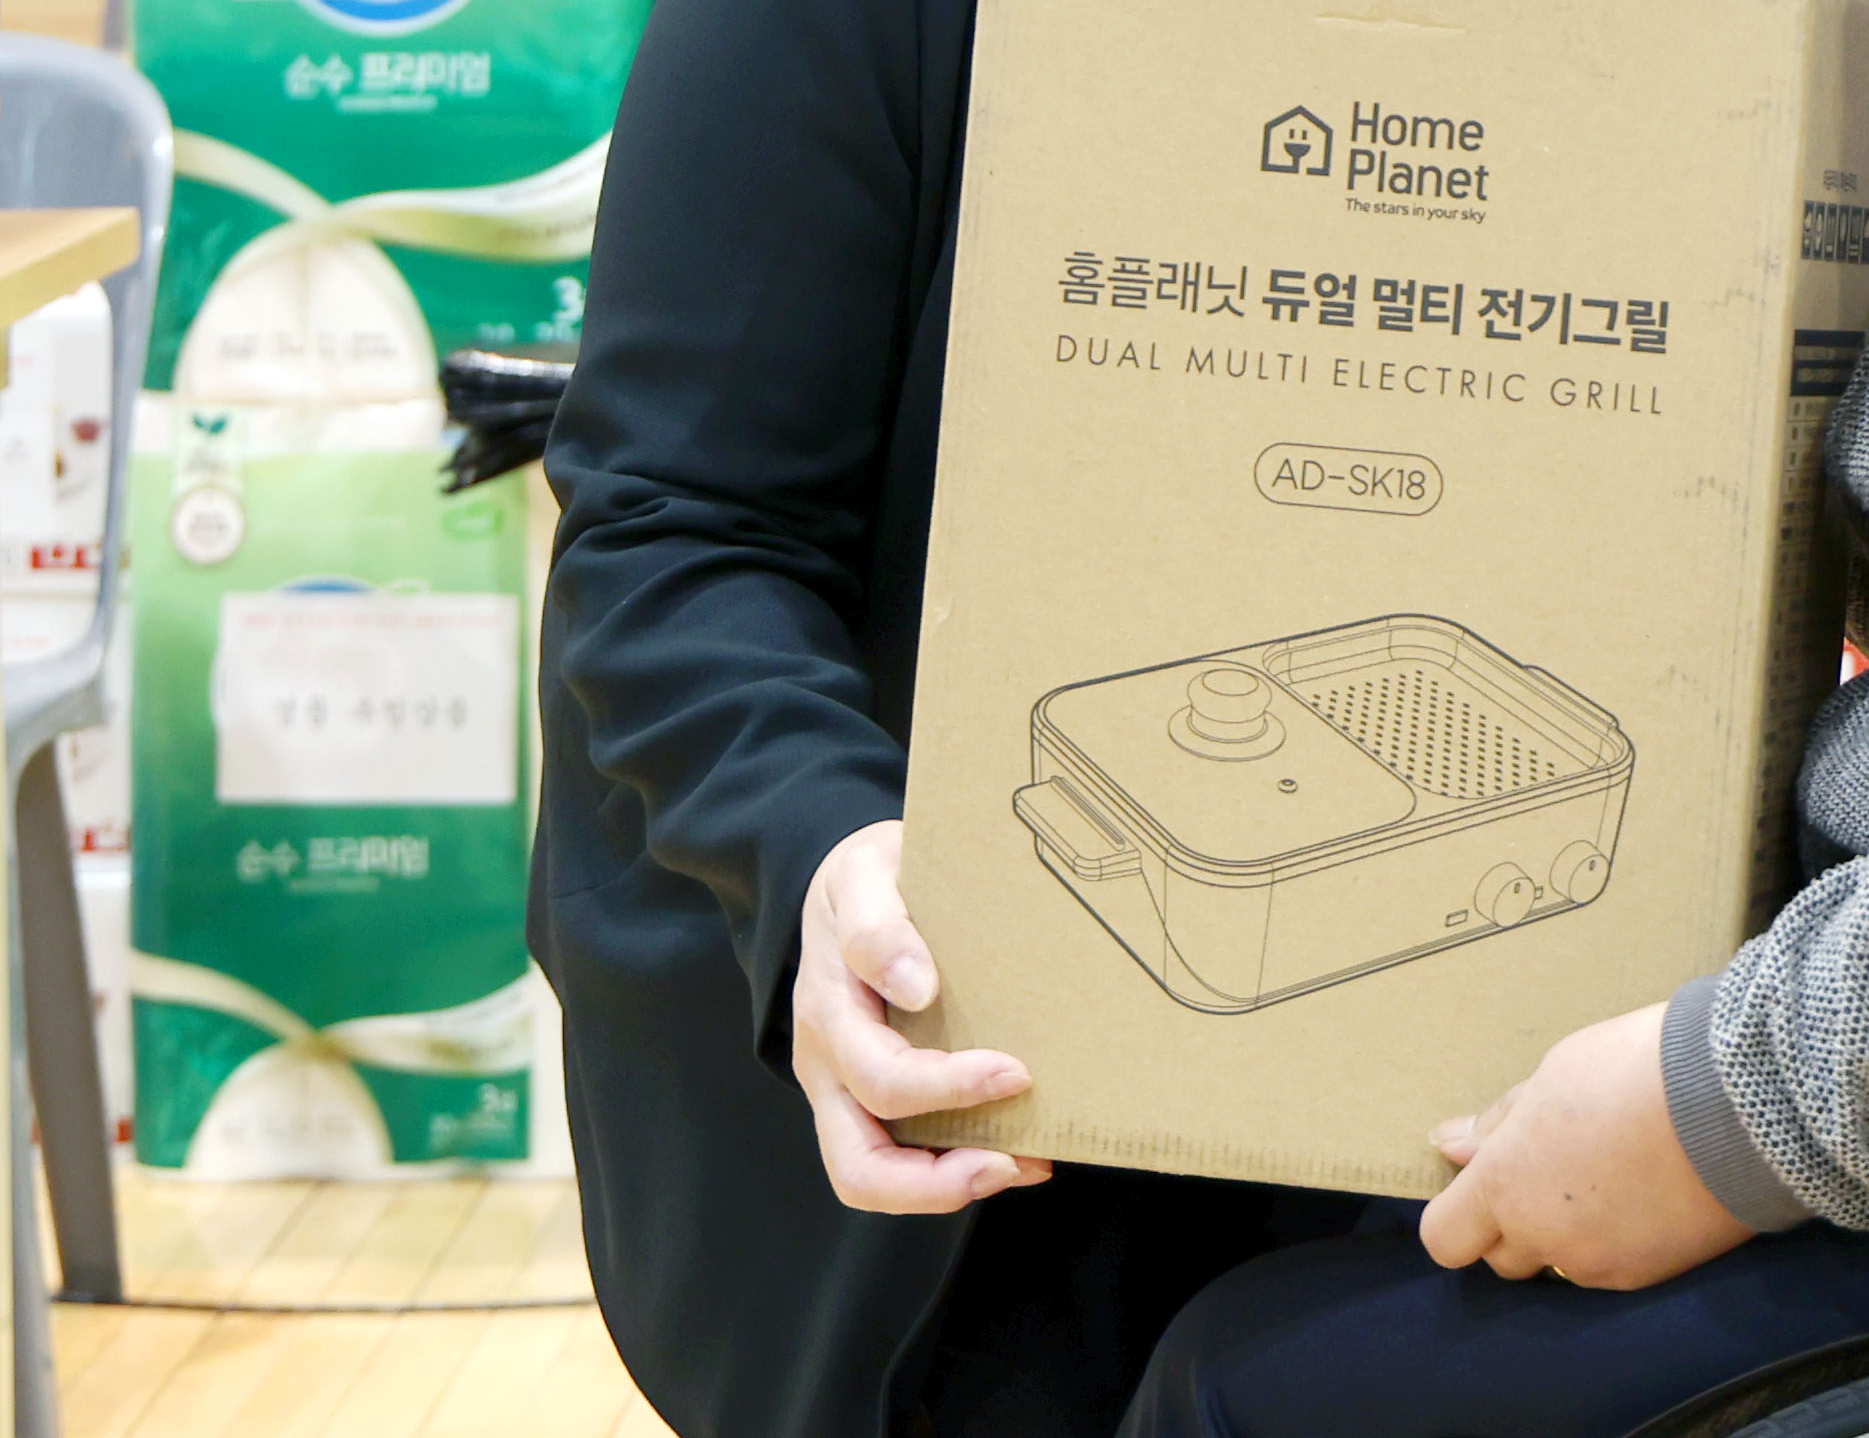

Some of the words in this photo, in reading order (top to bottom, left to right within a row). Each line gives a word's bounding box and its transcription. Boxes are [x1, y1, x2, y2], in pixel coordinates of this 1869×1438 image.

[283, 53, 354, 100] 순수
[360, 51, 491, 96] 프리미엄
[1350, 101, 1484, 152] Home
[1346, 148, 1490, 202] Planet
[1345, 197, 1371, 213] The
[1373, 202, 1409, 216] stars
[1412, 202, 1425, 217] in
[1426, 208, 1458, 221] your
[1461, 208, 1487, 225] sky
[1058, 251, 1248, 318] 홈플래닛
[1261, 269, 1357, 328] 듀얼
[1372, 278, 1464, 336] 멀티
[1477, 288, 1669, 355] 전기그릴
[1056, 334, 1161, 371] DUAL
[1185, 346, 1307, 383] MULTI
[1333, 358, 1526, 403] ELECTRIC
[1549, 377, 1662, 415] GRILL
[1271, 457, 1426, 501] AD-SK18
[307, 834, 430, 880] 프리미엄
